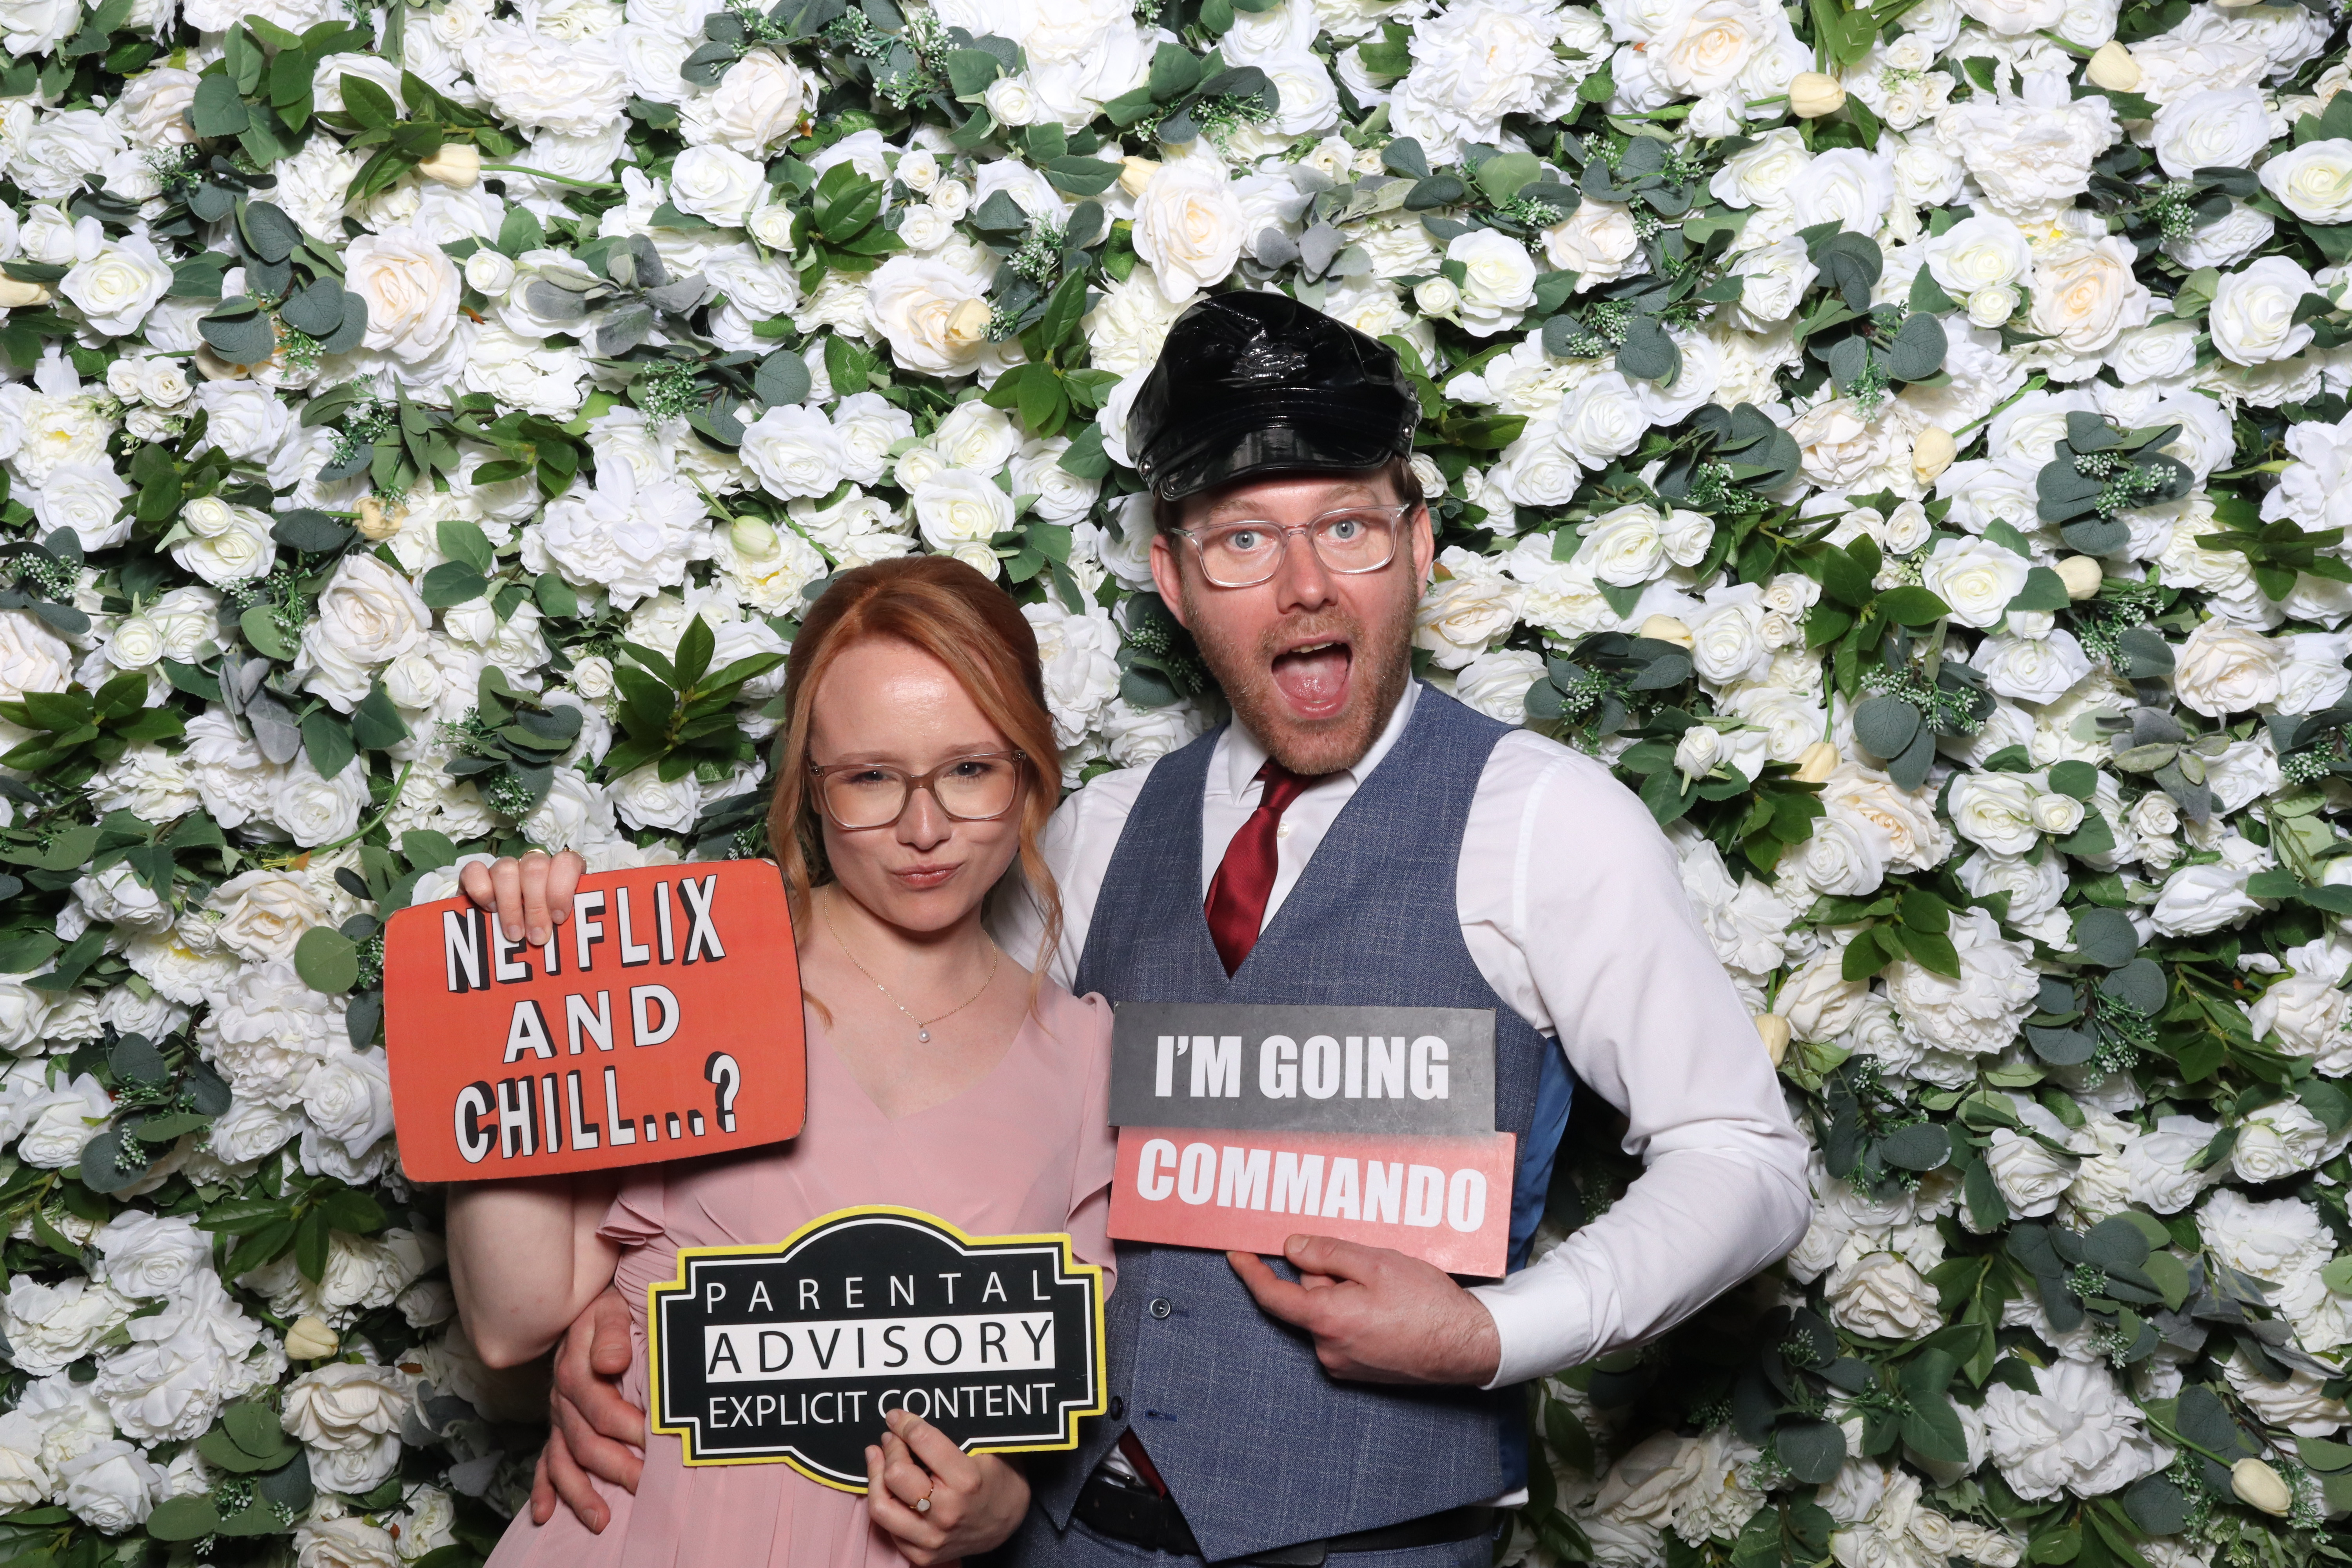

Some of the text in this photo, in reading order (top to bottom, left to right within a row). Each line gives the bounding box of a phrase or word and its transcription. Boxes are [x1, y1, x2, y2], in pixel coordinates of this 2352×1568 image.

[503, 984, 680, 1064] AND
[1155, 1034, 1449, 1100] I'M GOING
[454, 1051, 740, 1164] CHILL...?
[1137, 1138, 1487, 1232] COMMANDO
[707, 1270, 1051, 1314] PARENTAL
[708, 1320, 1052, 1374] ADVISORY
[710, 1383, 1055, 1428] EXPLICIT CONTENT
